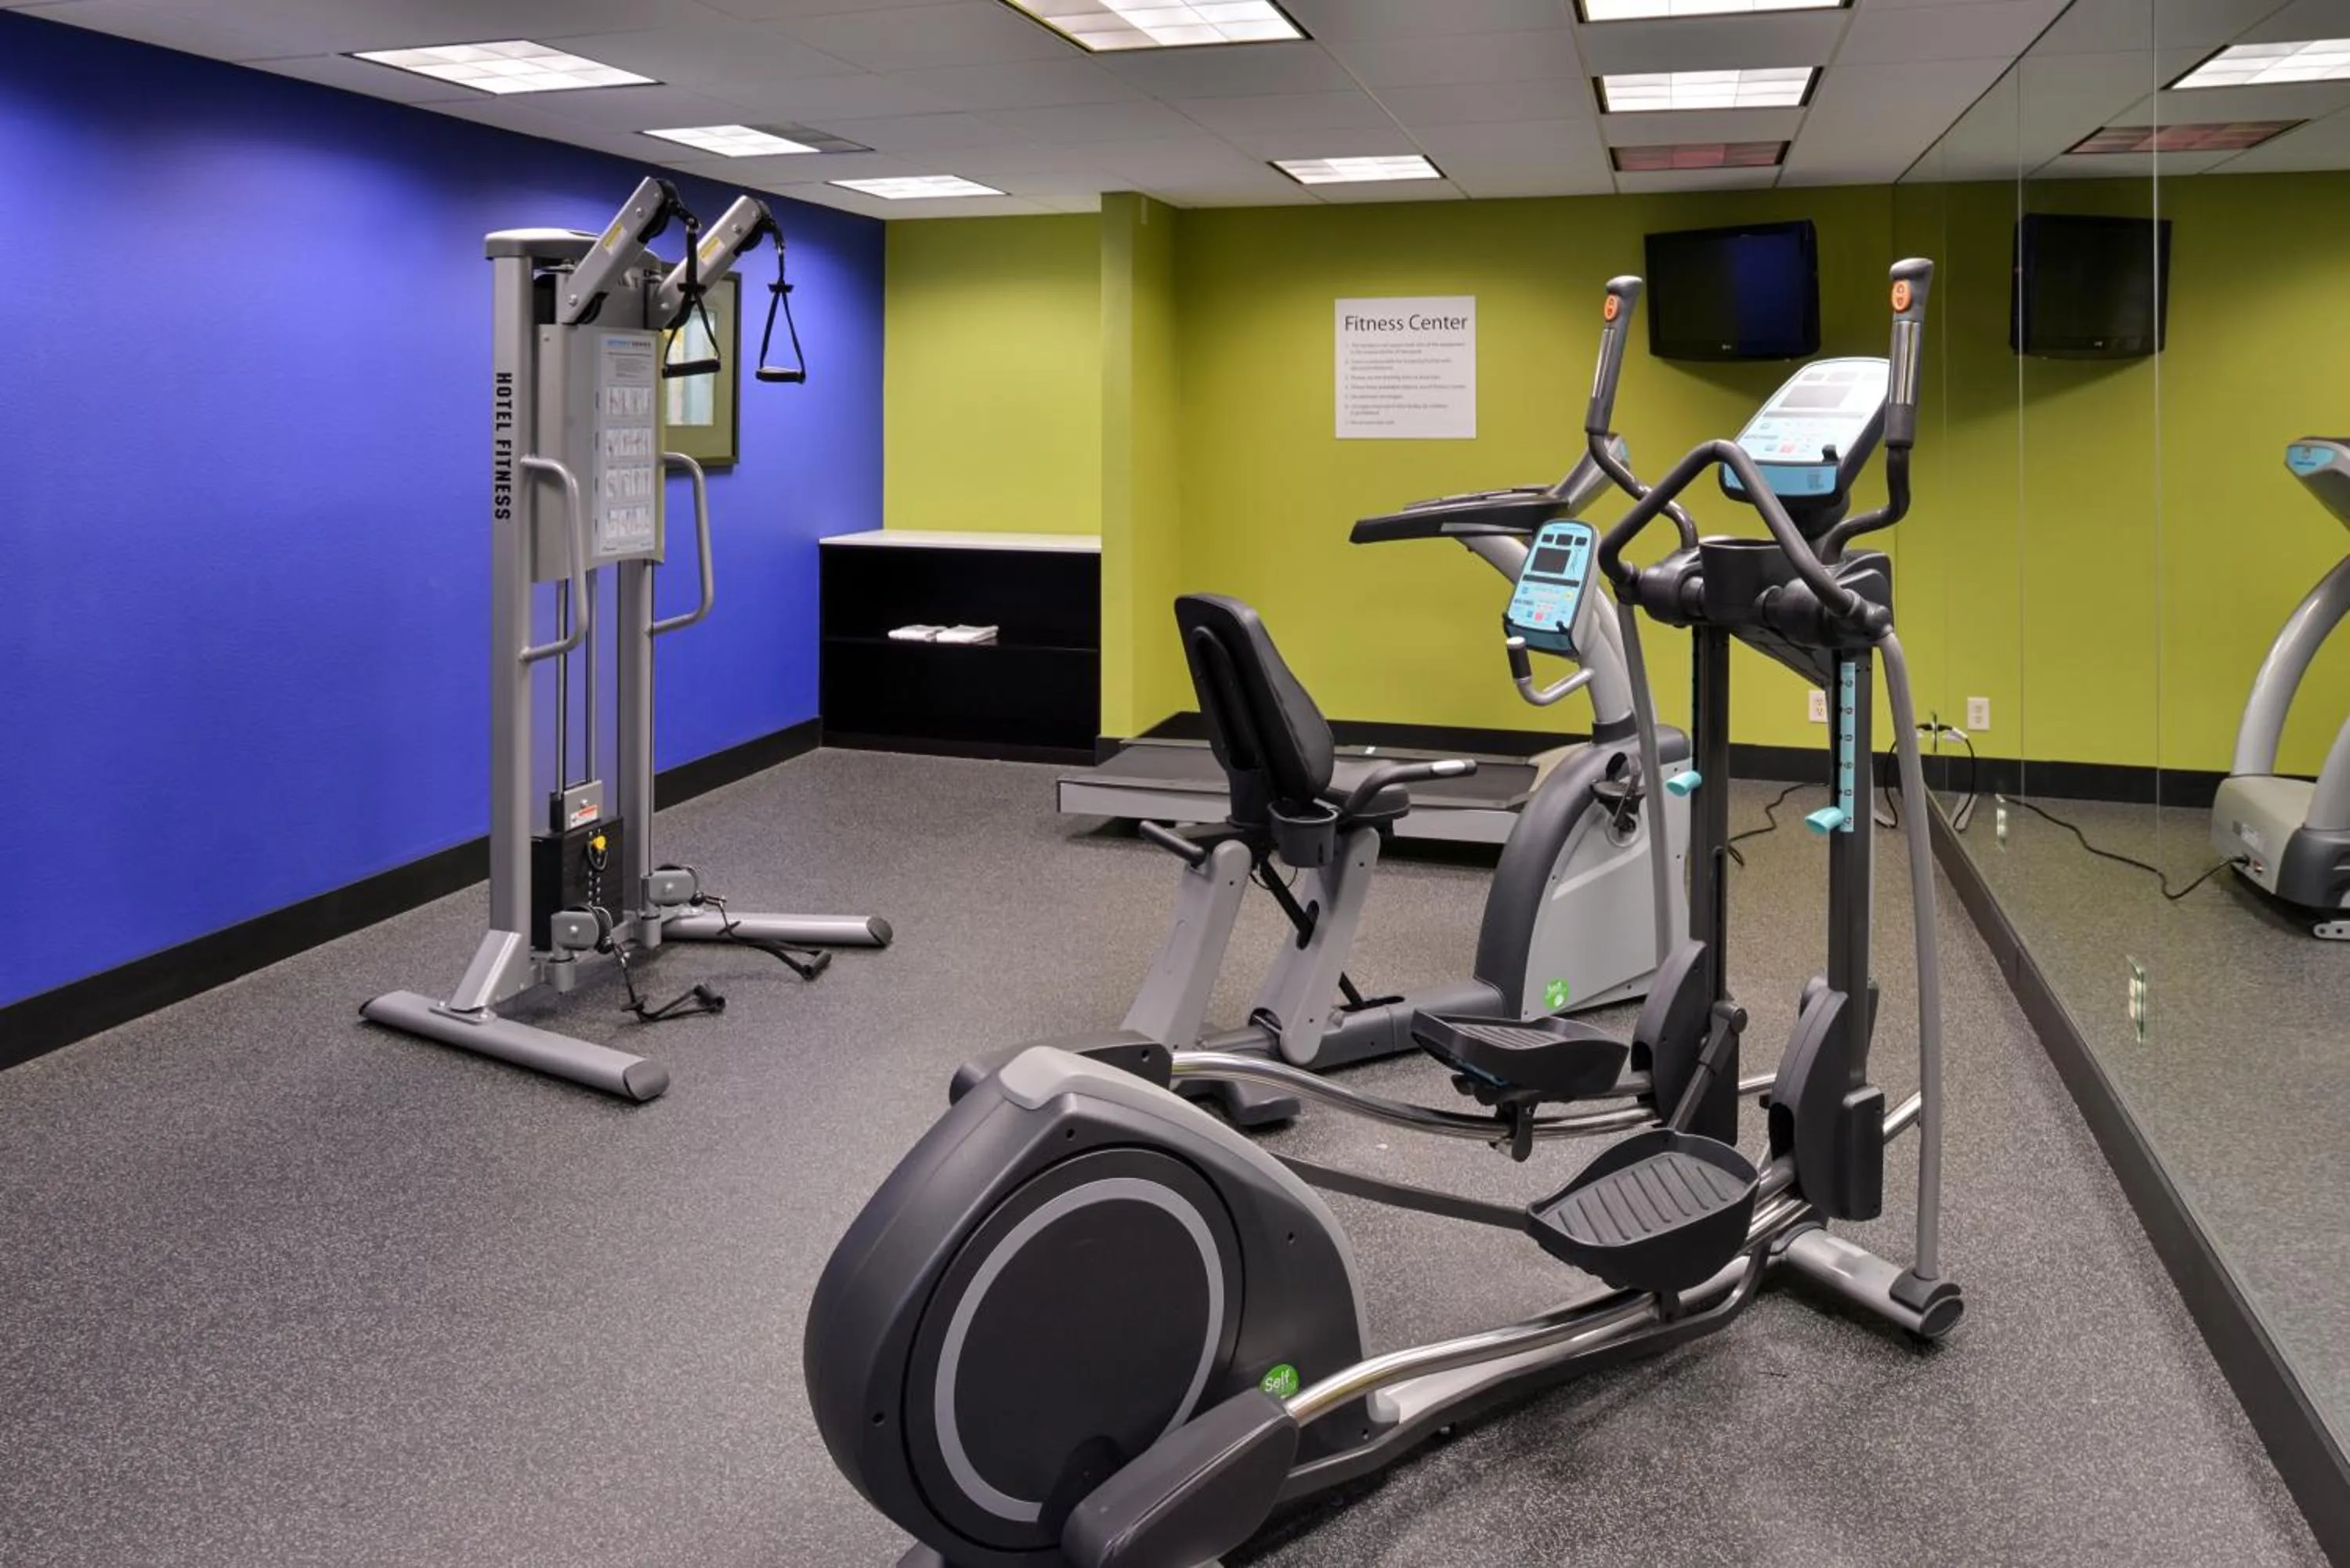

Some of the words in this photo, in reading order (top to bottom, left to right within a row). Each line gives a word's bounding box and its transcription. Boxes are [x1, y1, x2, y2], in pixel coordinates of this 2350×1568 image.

[1344, 315, 1405, 332] Fitness
[1408, 313, 1469, 331] Center
[495, 372, 513, 432] HOTEL
[494, 439, 512, 520] FITNESS
